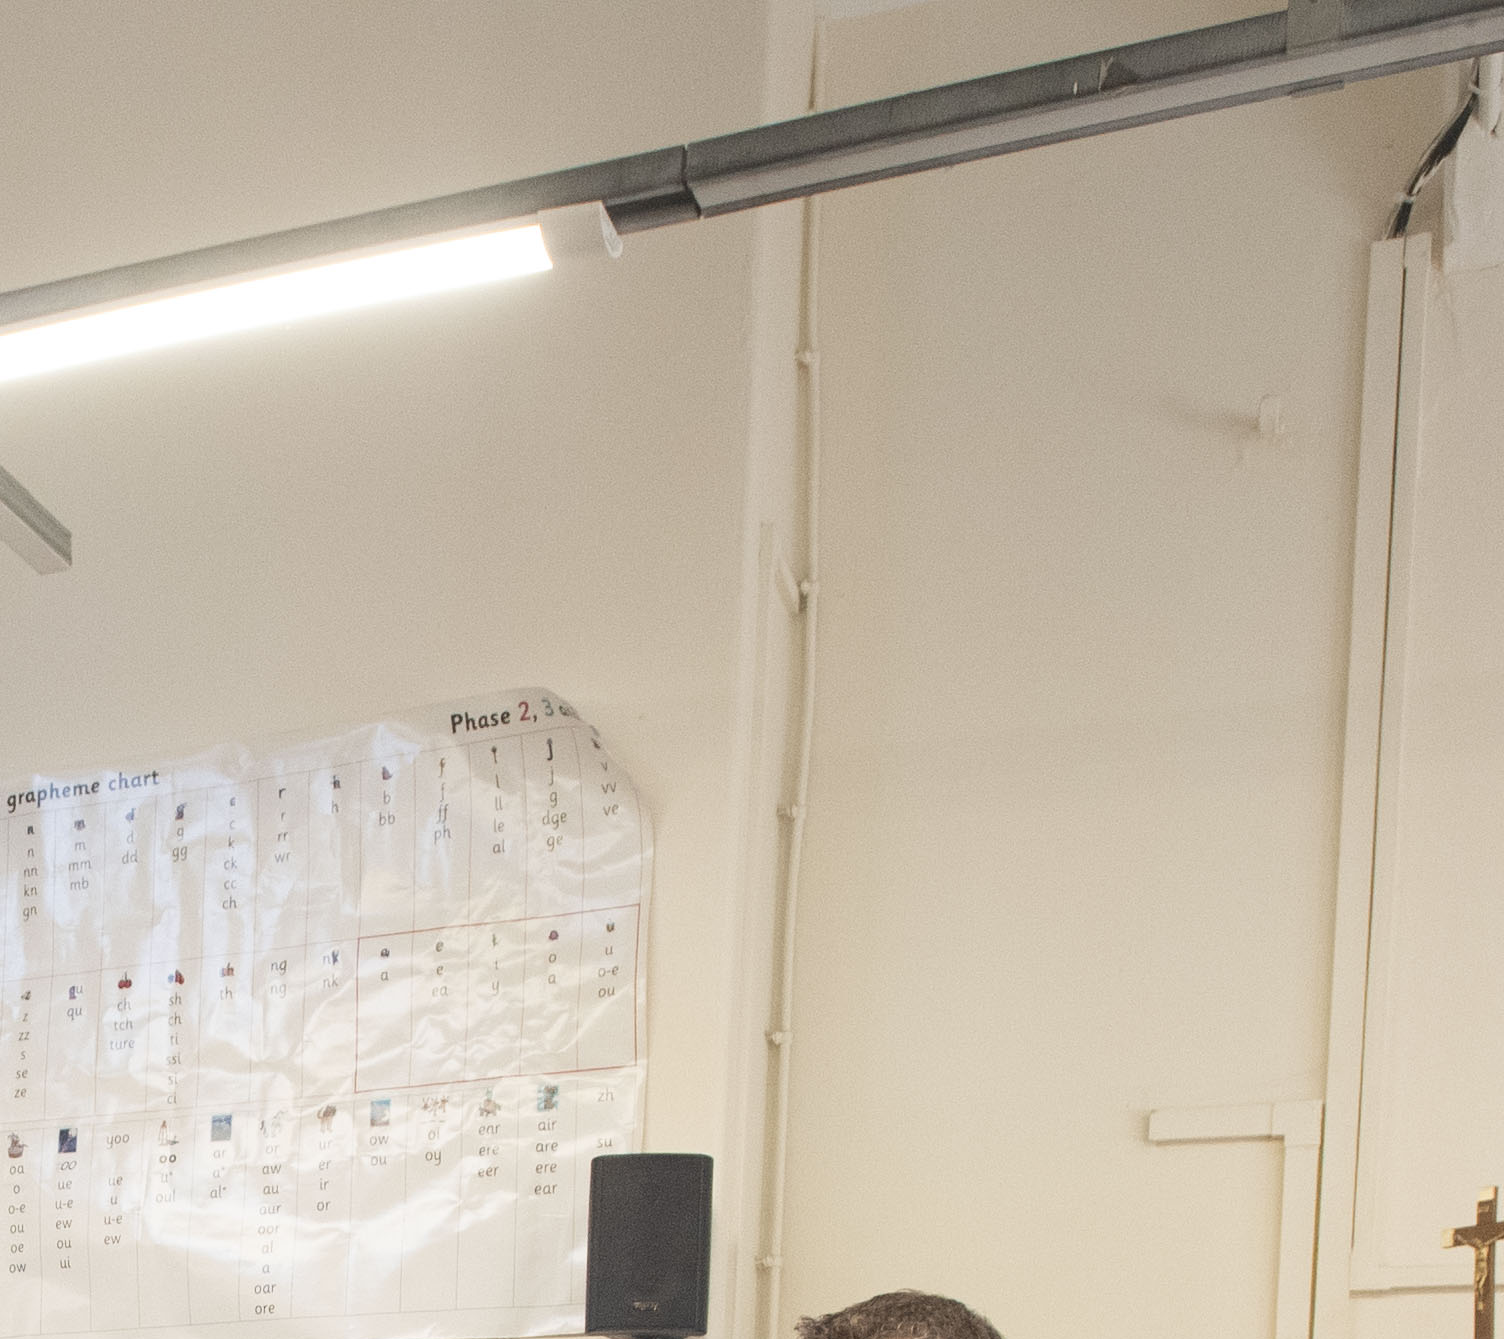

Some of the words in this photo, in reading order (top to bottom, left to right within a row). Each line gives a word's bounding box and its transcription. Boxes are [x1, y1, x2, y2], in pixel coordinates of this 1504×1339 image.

[450, 710, 510, 733] Phase
[7, 780, 100, 813] grapheme
[109, 770, 159, 792] chart
